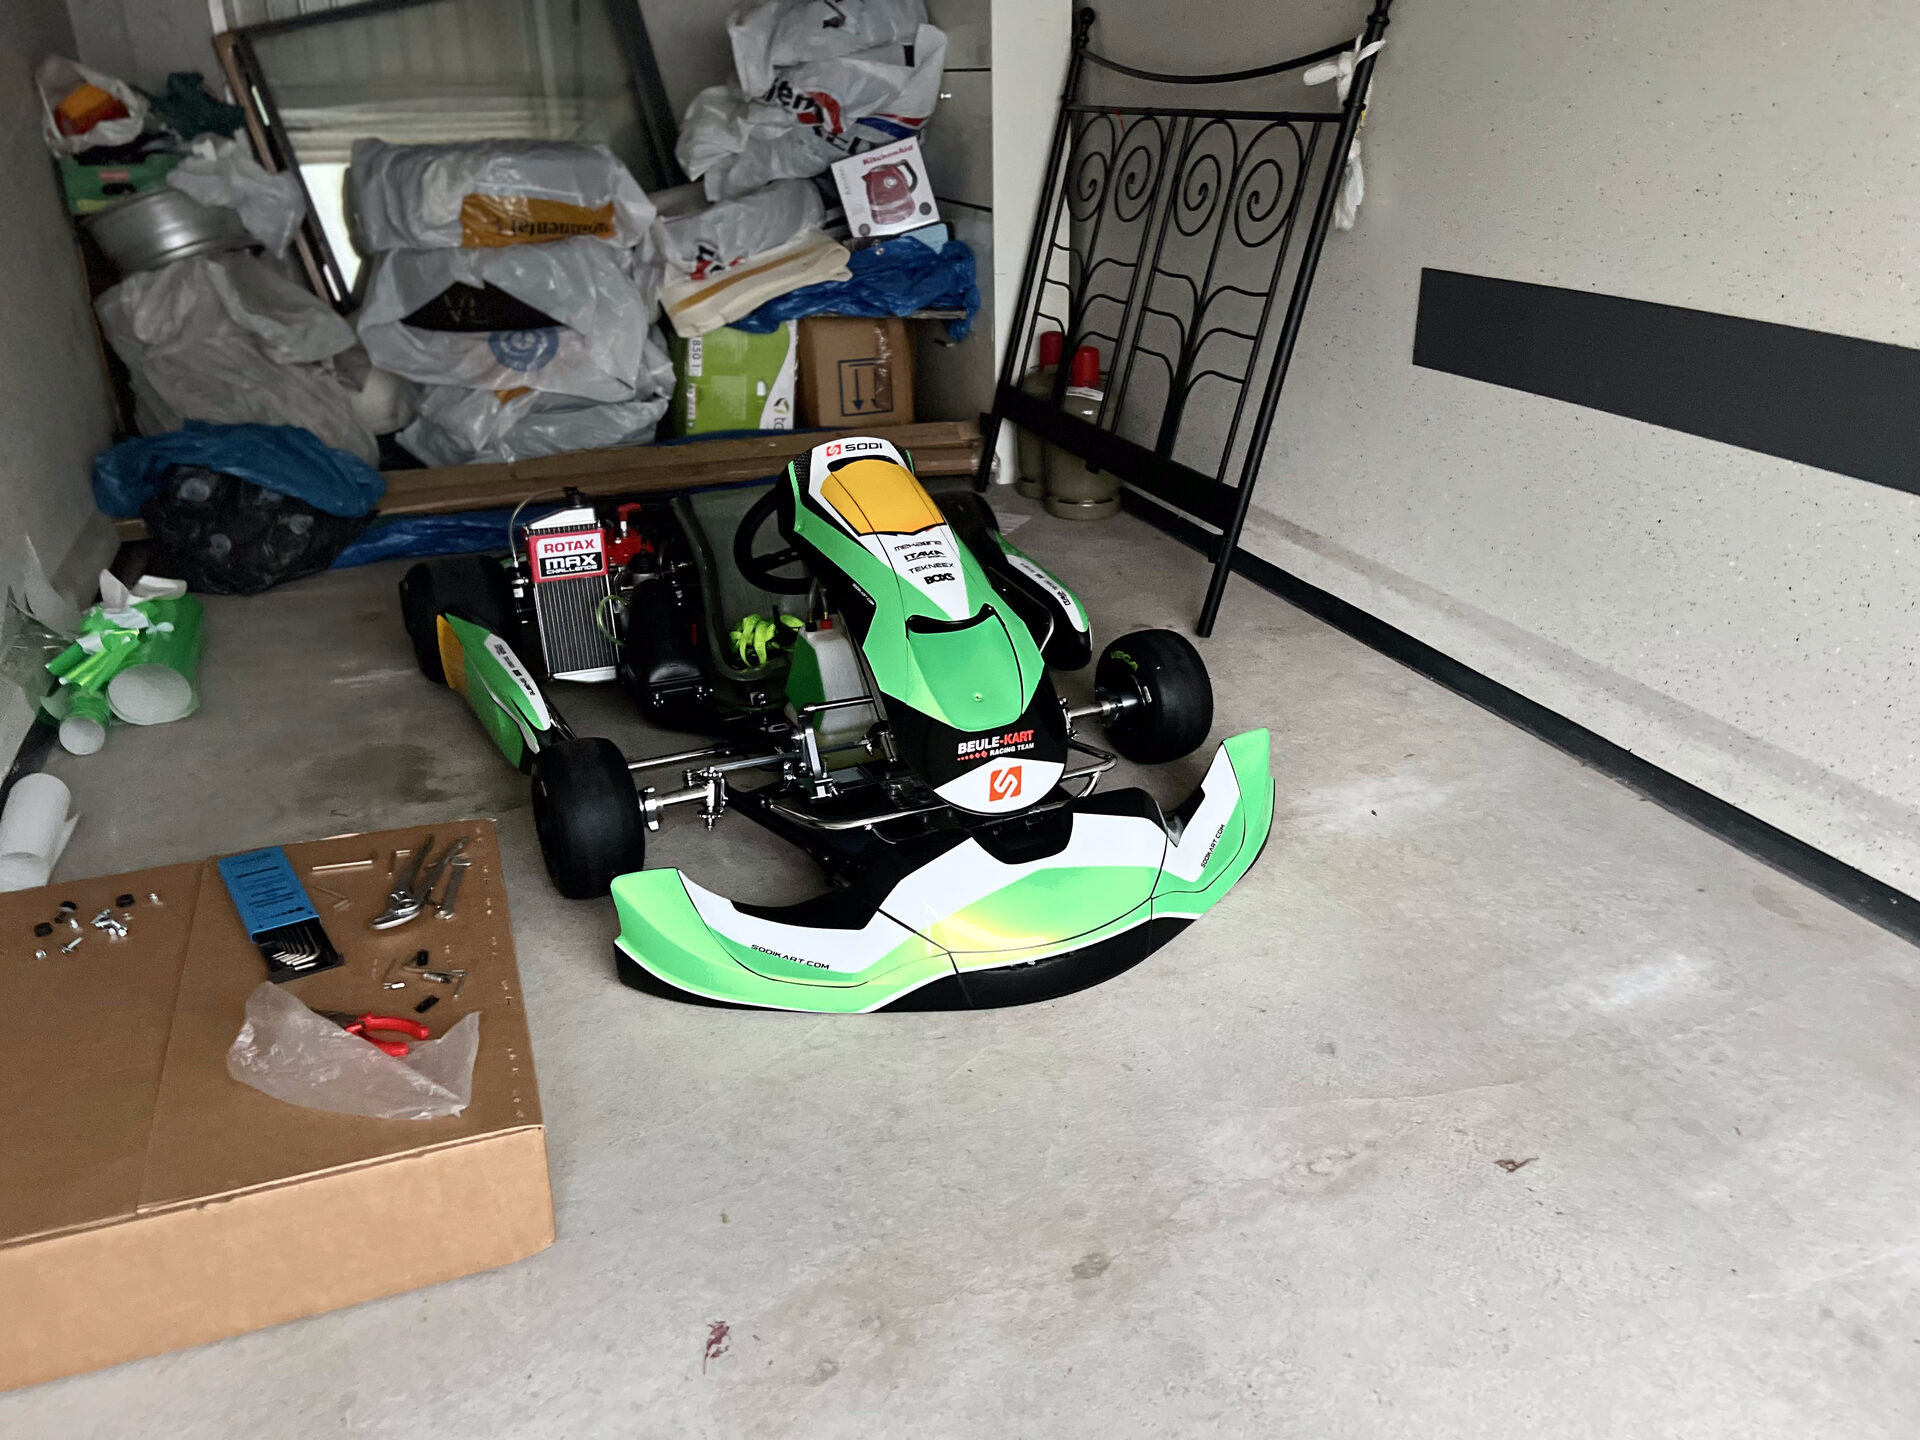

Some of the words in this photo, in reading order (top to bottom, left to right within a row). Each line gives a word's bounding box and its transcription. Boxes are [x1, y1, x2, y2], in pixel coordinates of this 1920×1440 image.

[845, 442, 883, 452] SODI
[543, 539, 595, 554] ROTAX
[904, 550, 945, 561] ITAKA
[908, 562, 955, 574] TEKNEEX
[957, 729, 1034, 755] BEULE-KART
[989, 745, 1016, 757] RACING
[1017, 742, 1035, 751] TEAM
